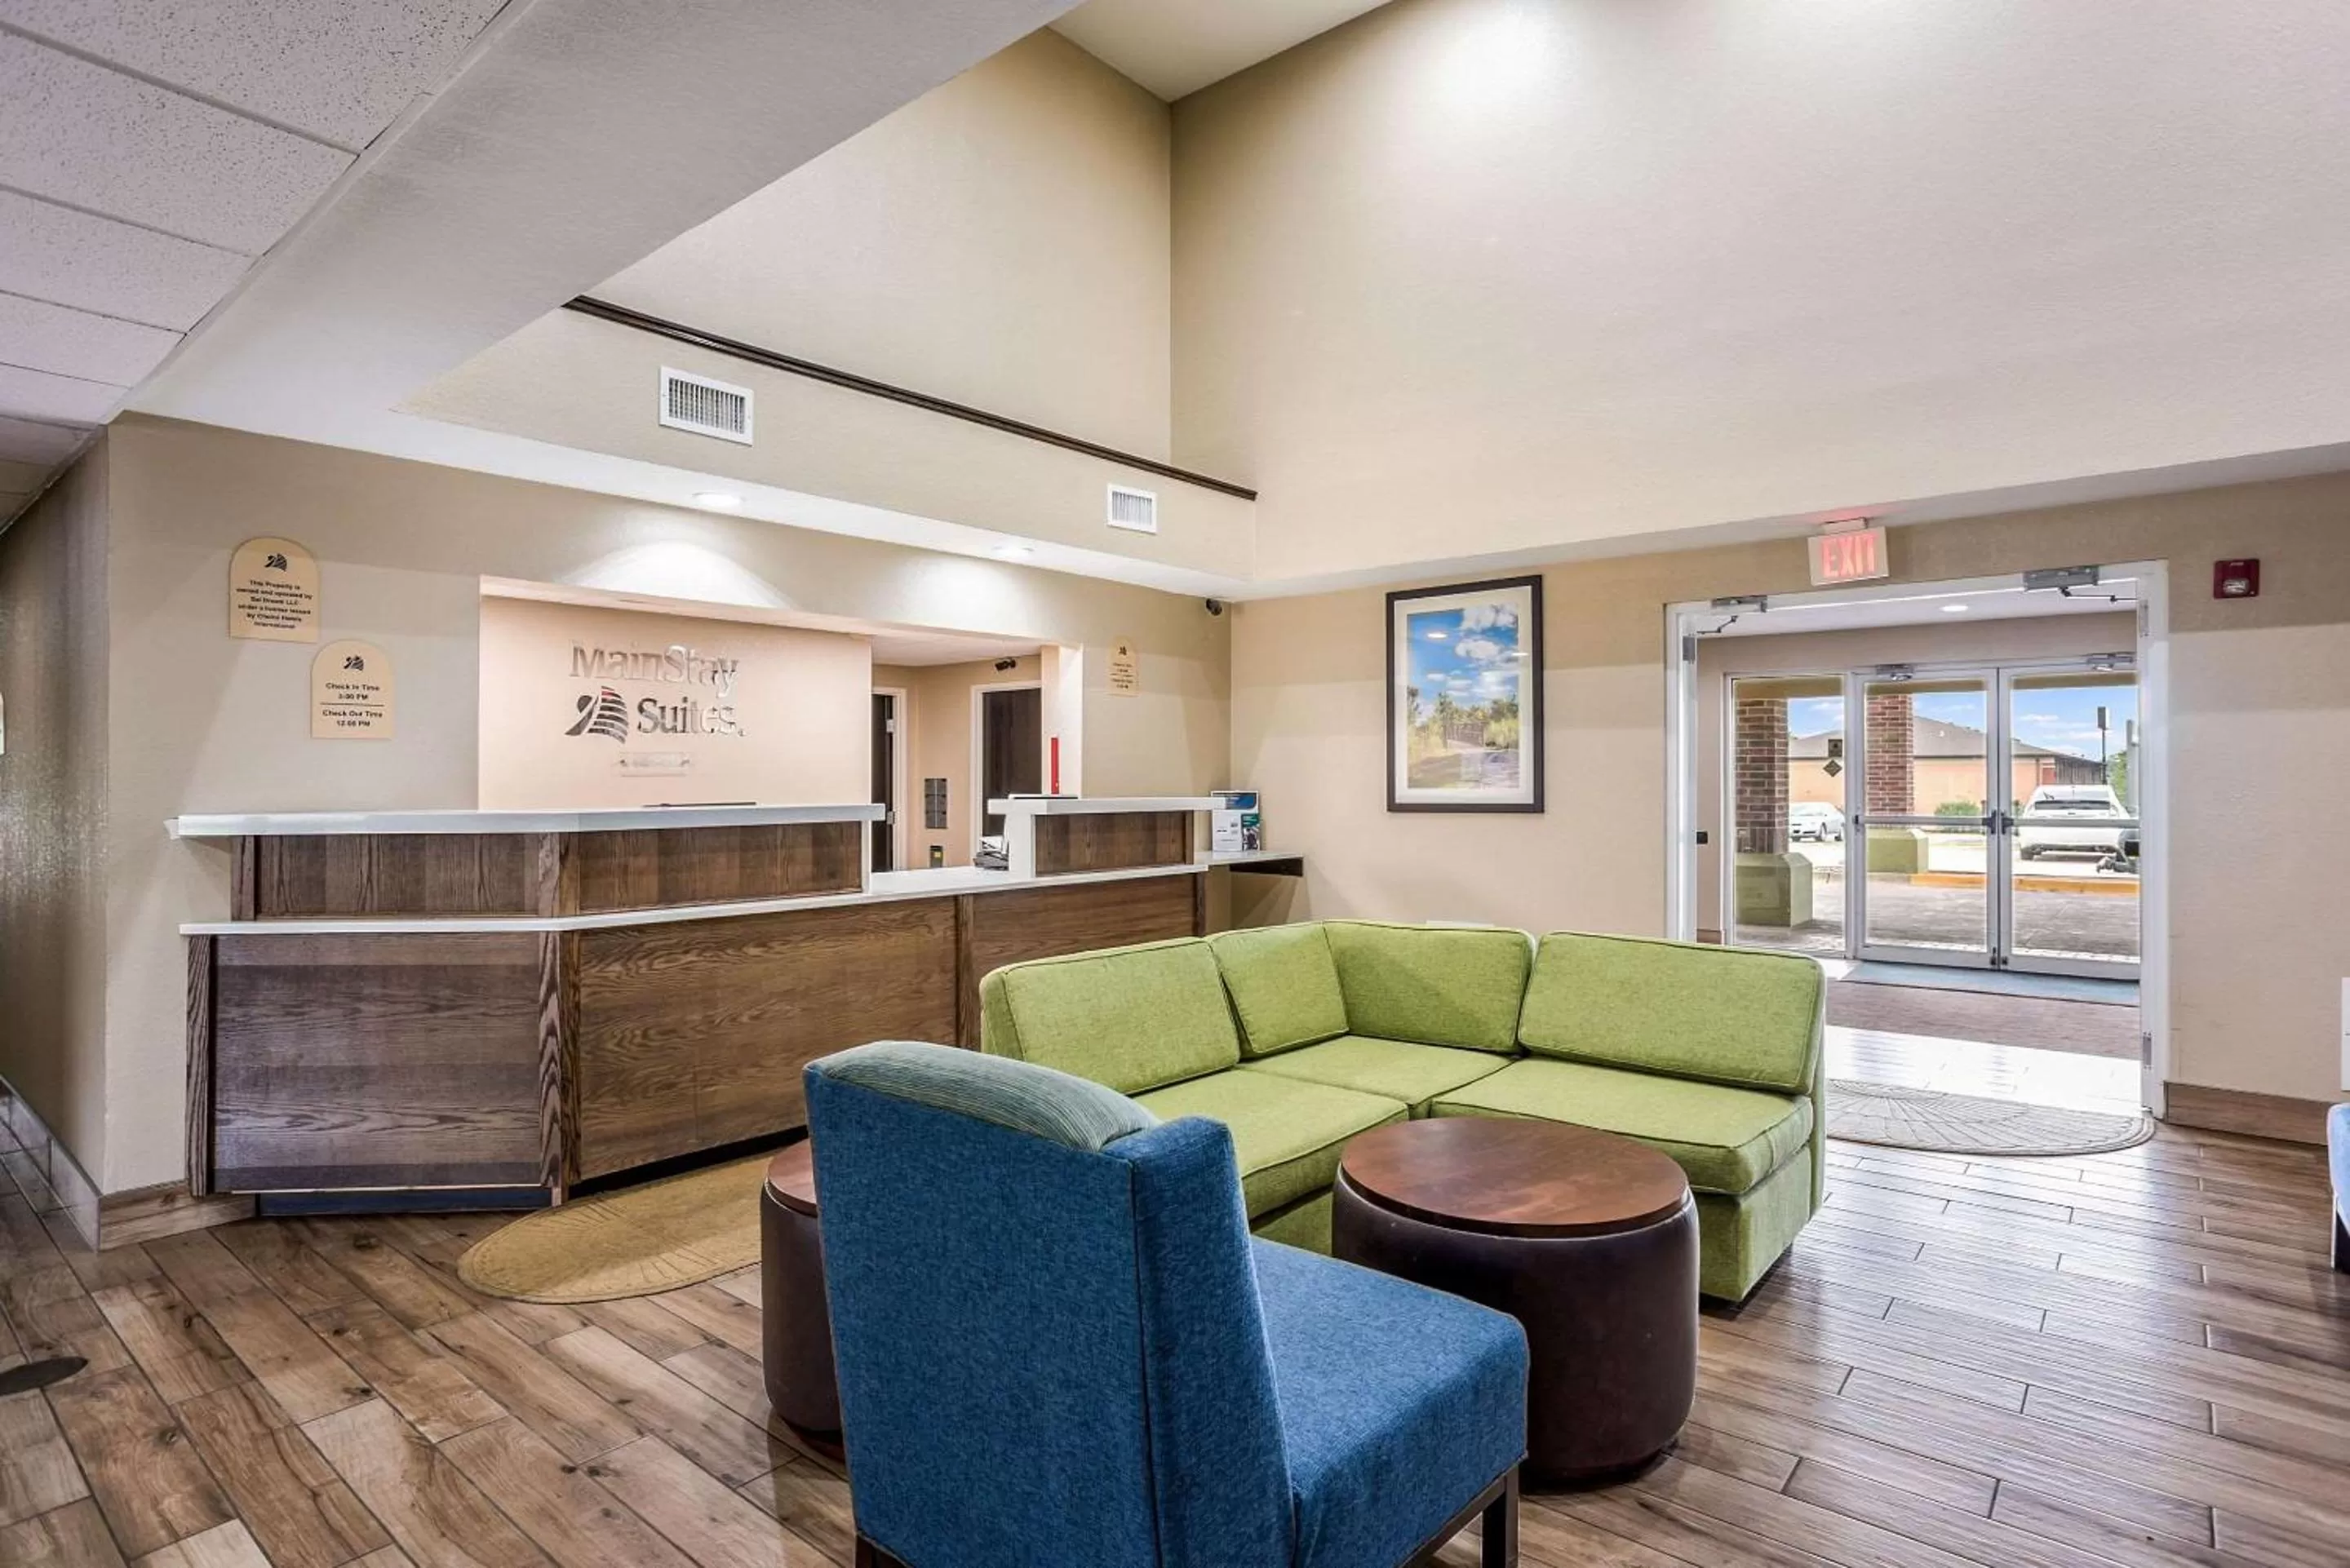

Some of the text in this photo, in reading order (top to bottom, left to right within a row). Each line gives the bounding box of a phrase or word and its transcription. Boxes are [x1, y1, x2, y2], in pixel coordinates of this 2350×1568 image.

[1820, 532, 1879, 578] EXIT
[326, 682, 350, 690] Check
[362, 684, 380, 692] Time
[569, 641, 740, 698] MainStay
[321, 709, 347, 717] Check
[636, 695, 738, 735] Suites
